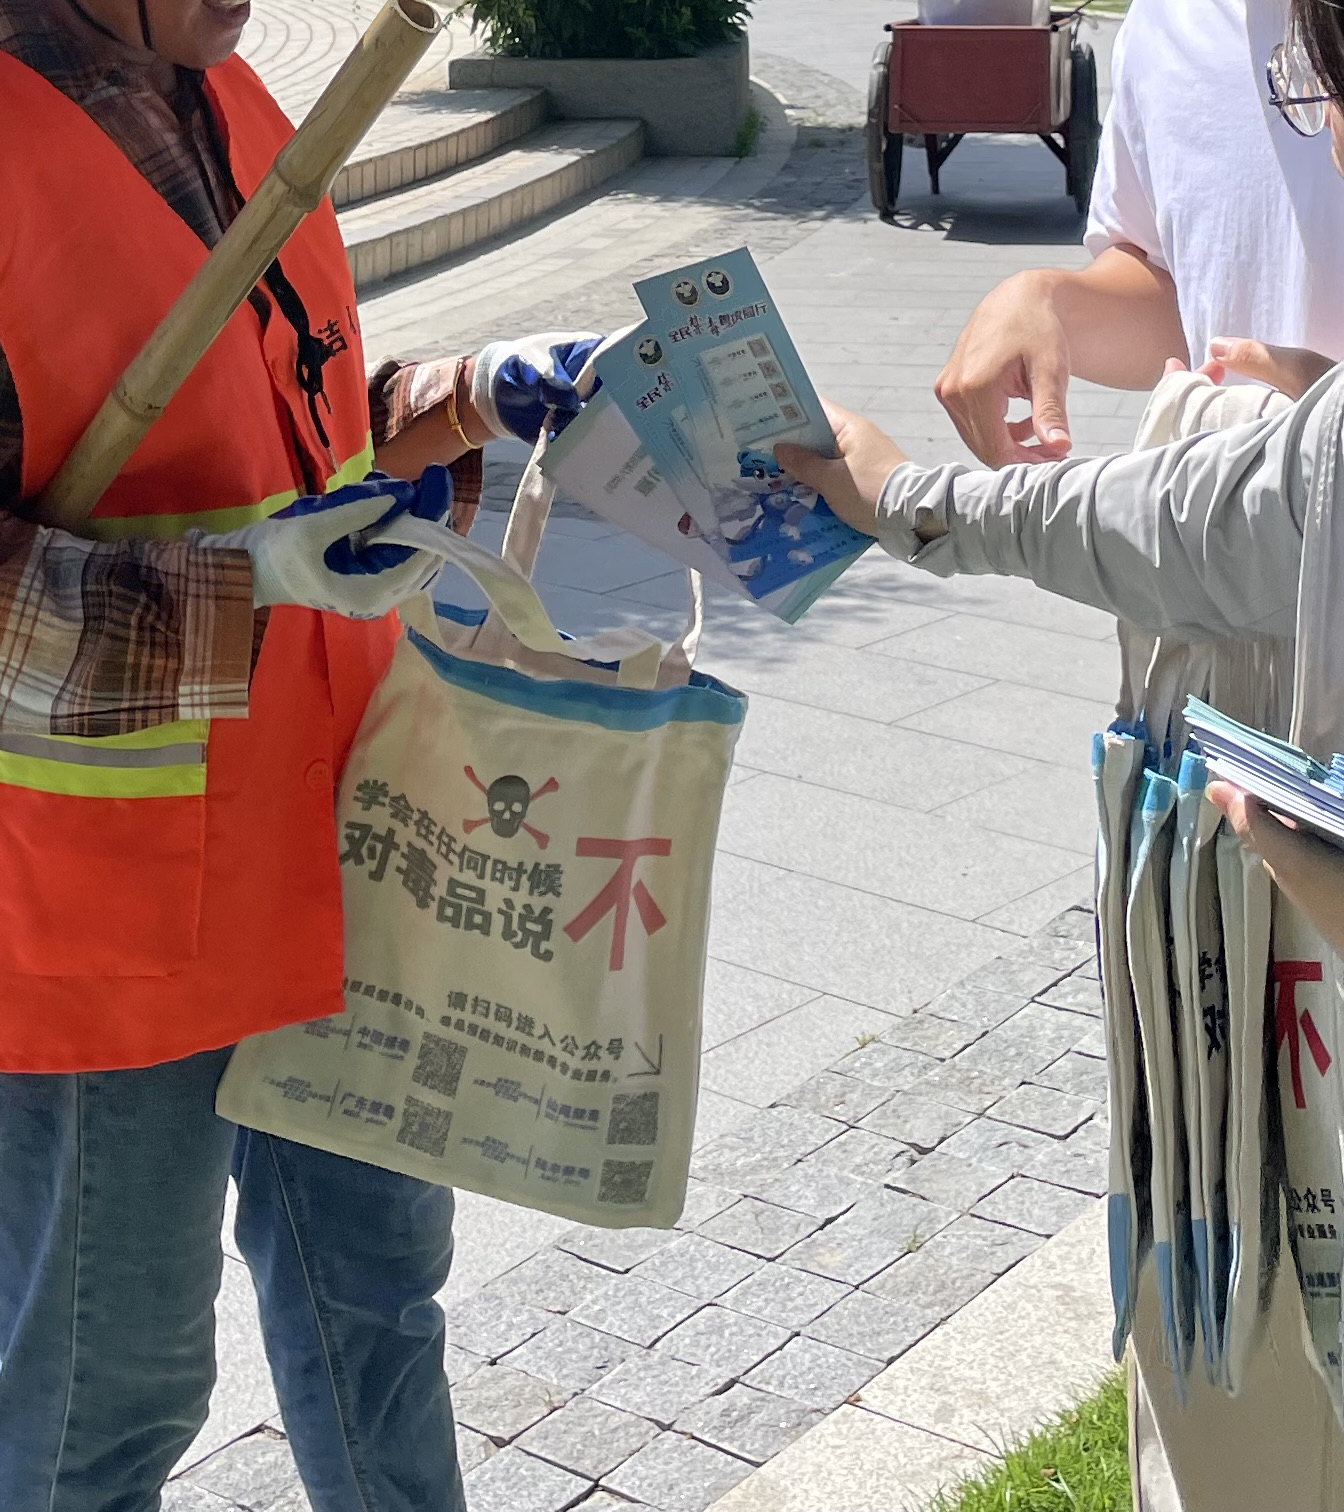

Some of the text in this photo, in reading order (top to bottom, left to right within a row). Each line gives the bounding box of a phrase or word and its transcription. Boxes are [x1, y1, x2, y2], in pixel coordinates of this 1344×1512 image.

[339, 821, 554, 962] 对毒品说
[353, 779, 563, 898] 学会在任何时候
[563, 837, 672, 972] 不
[447, 990, 624, 1061] 请扫码进入公众号
